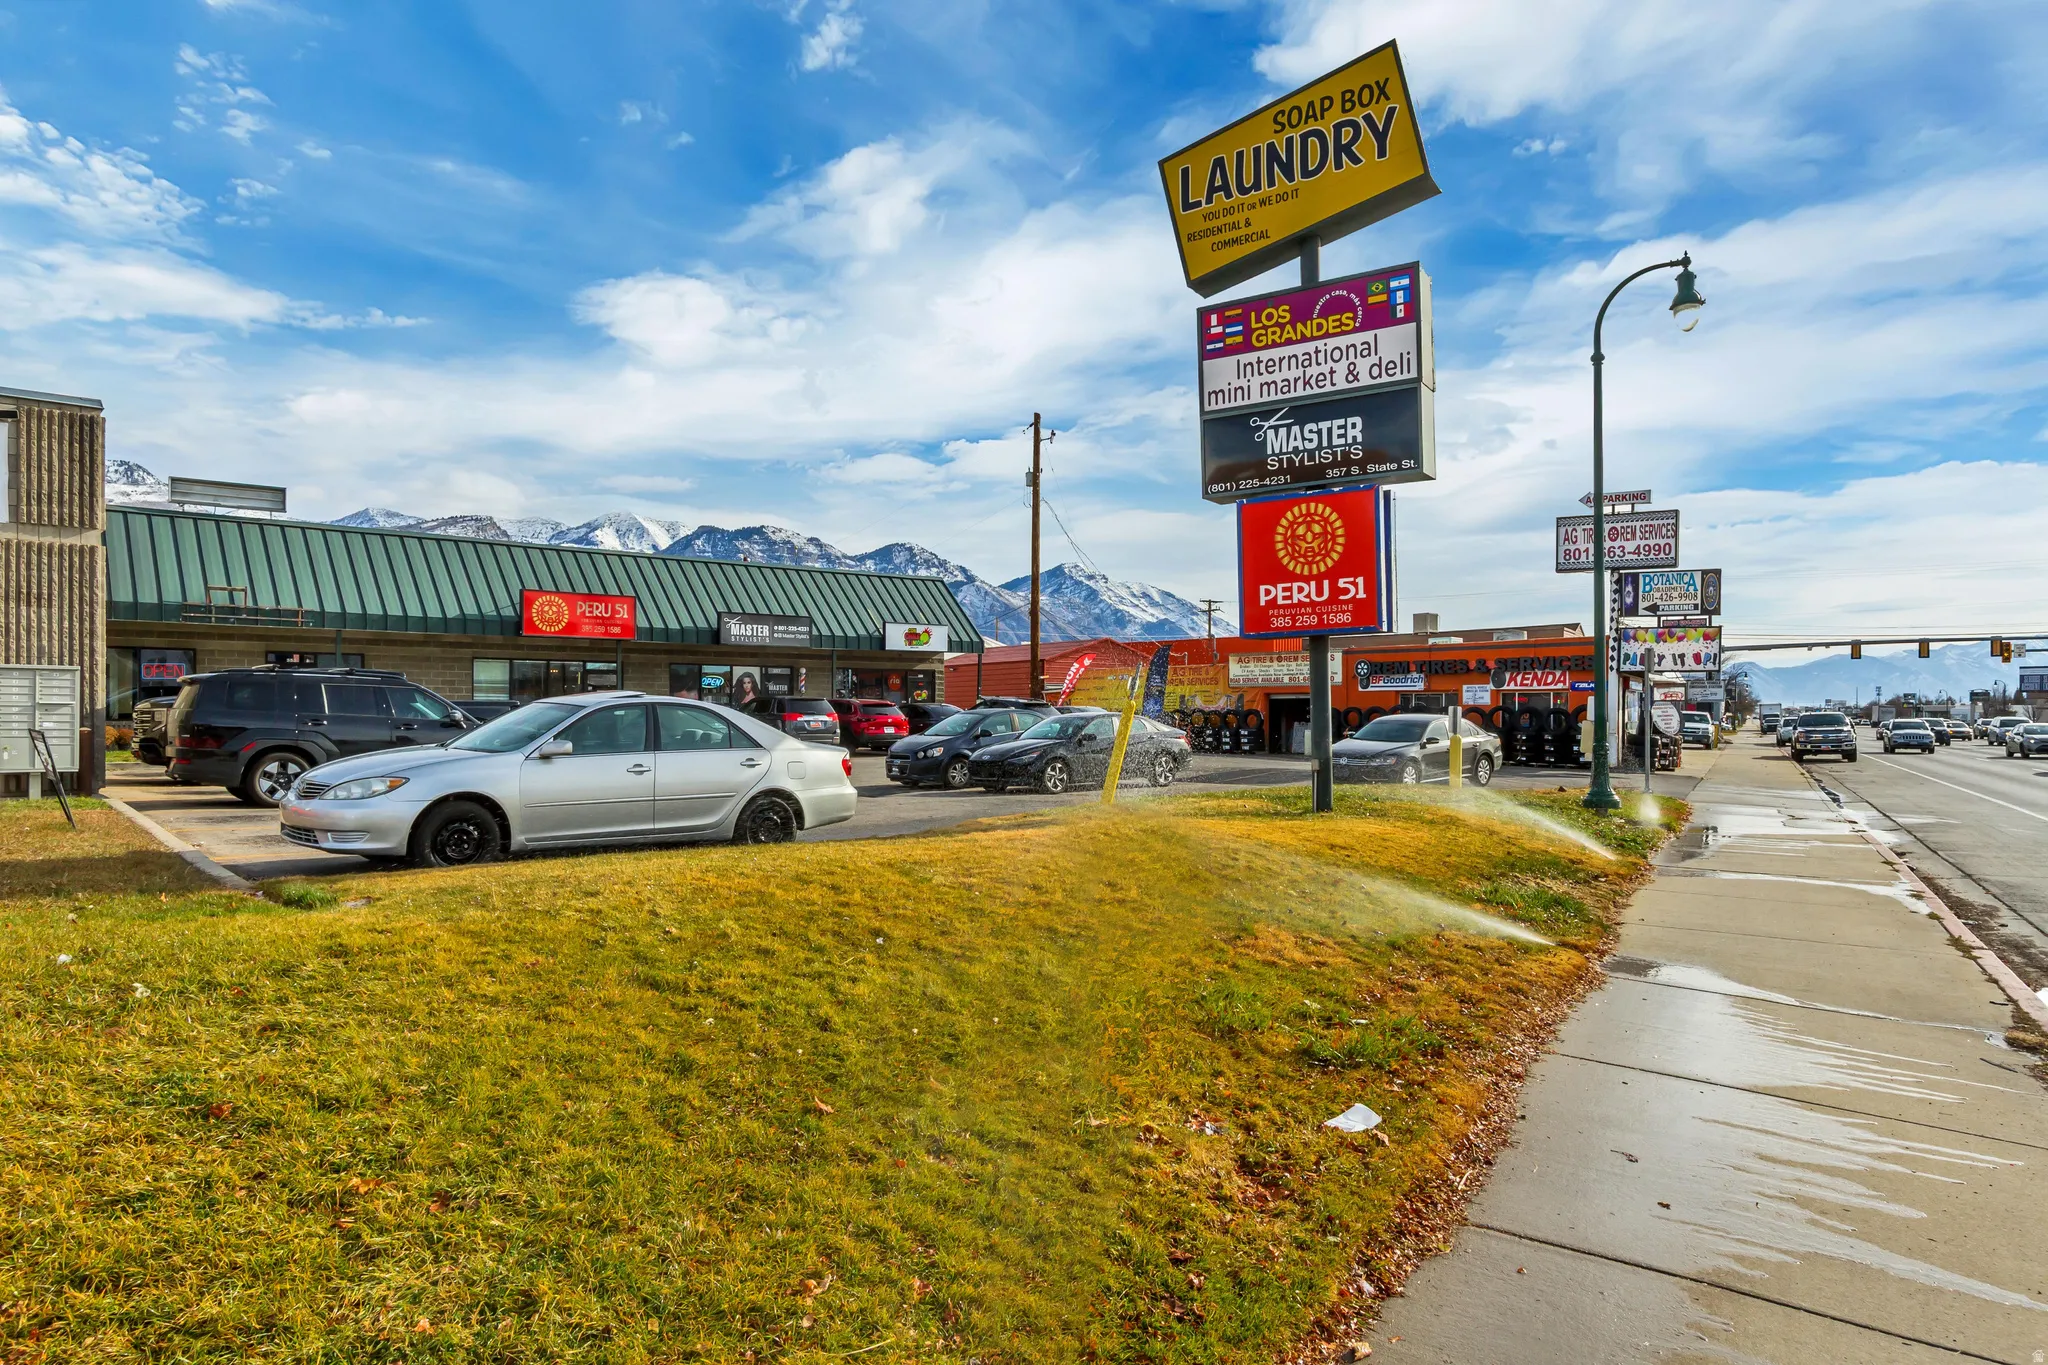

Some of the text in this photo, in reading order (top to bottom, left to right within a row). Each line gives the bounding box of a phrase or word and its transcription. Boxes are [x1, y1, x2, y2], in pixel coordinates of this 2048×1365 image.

[1273, 78, 1390, 134] SOAP BOX
[1179, 105, 1398, 213] LAUNDRY
[1202, 188, 1300, 223] YOU DO IT OR WE DO IT
[1187, 217, 1252, 242] RESIDENTIAL &
[1211, 229, 1270, 252] COMMERCIAL
[1312, 294, 1330, 318] nuestra
[1250, 305, 1291, 328] LOS
[1252, 312, 1354, 348] GRANDES
[1237, 334, 1378, 380] International
[1208, 351, 1411, 406] mini market & deli
[1266, 416, 1362, 455] MASTER
[1267, 445, 1363, 470] STYLIST'S
[1326, 460, 1418, 478] 357 S. State St.
[1208, 475, 1291, 494] (801) 225-4231
[1603, 492, 1646, 503] PARKING
[1563, 528, 1578, 545] AG
[1582, 528, 1594, 544] TIR
[1639, 522, 1676, 540] SERVICES
[1260, 576, 1366, 606] PERU 51
[1642, 572, 1698, 593] BOTANICA
[1642, 592, 1698, 602] 801-426-9908
[576, 602, 628, 618] PERU 51
[1268, 604, 1354, 615] PERUVIAN CUISINE
[731, 624, 769, 636] MASTER
[1270, 612, 1352, 628] 385 259 1586
[1412, 659, 1469, 674] TIRES
[1474, 658, 1489, 672] &
[1494, 655, 1595, 671] SERVICES
[1672, 652, 1686, 668] IT
[1692, 651, 1718, 666] UP!
[143, 664, 184, 678] OPEN
[1370, 674, 1423, 684] BFGoodrich
[1506, 671, 1568, 687] KENDA
[702, 677, 722, 686] OPEN
[1187, 677, 1219, 686] SERVICES
